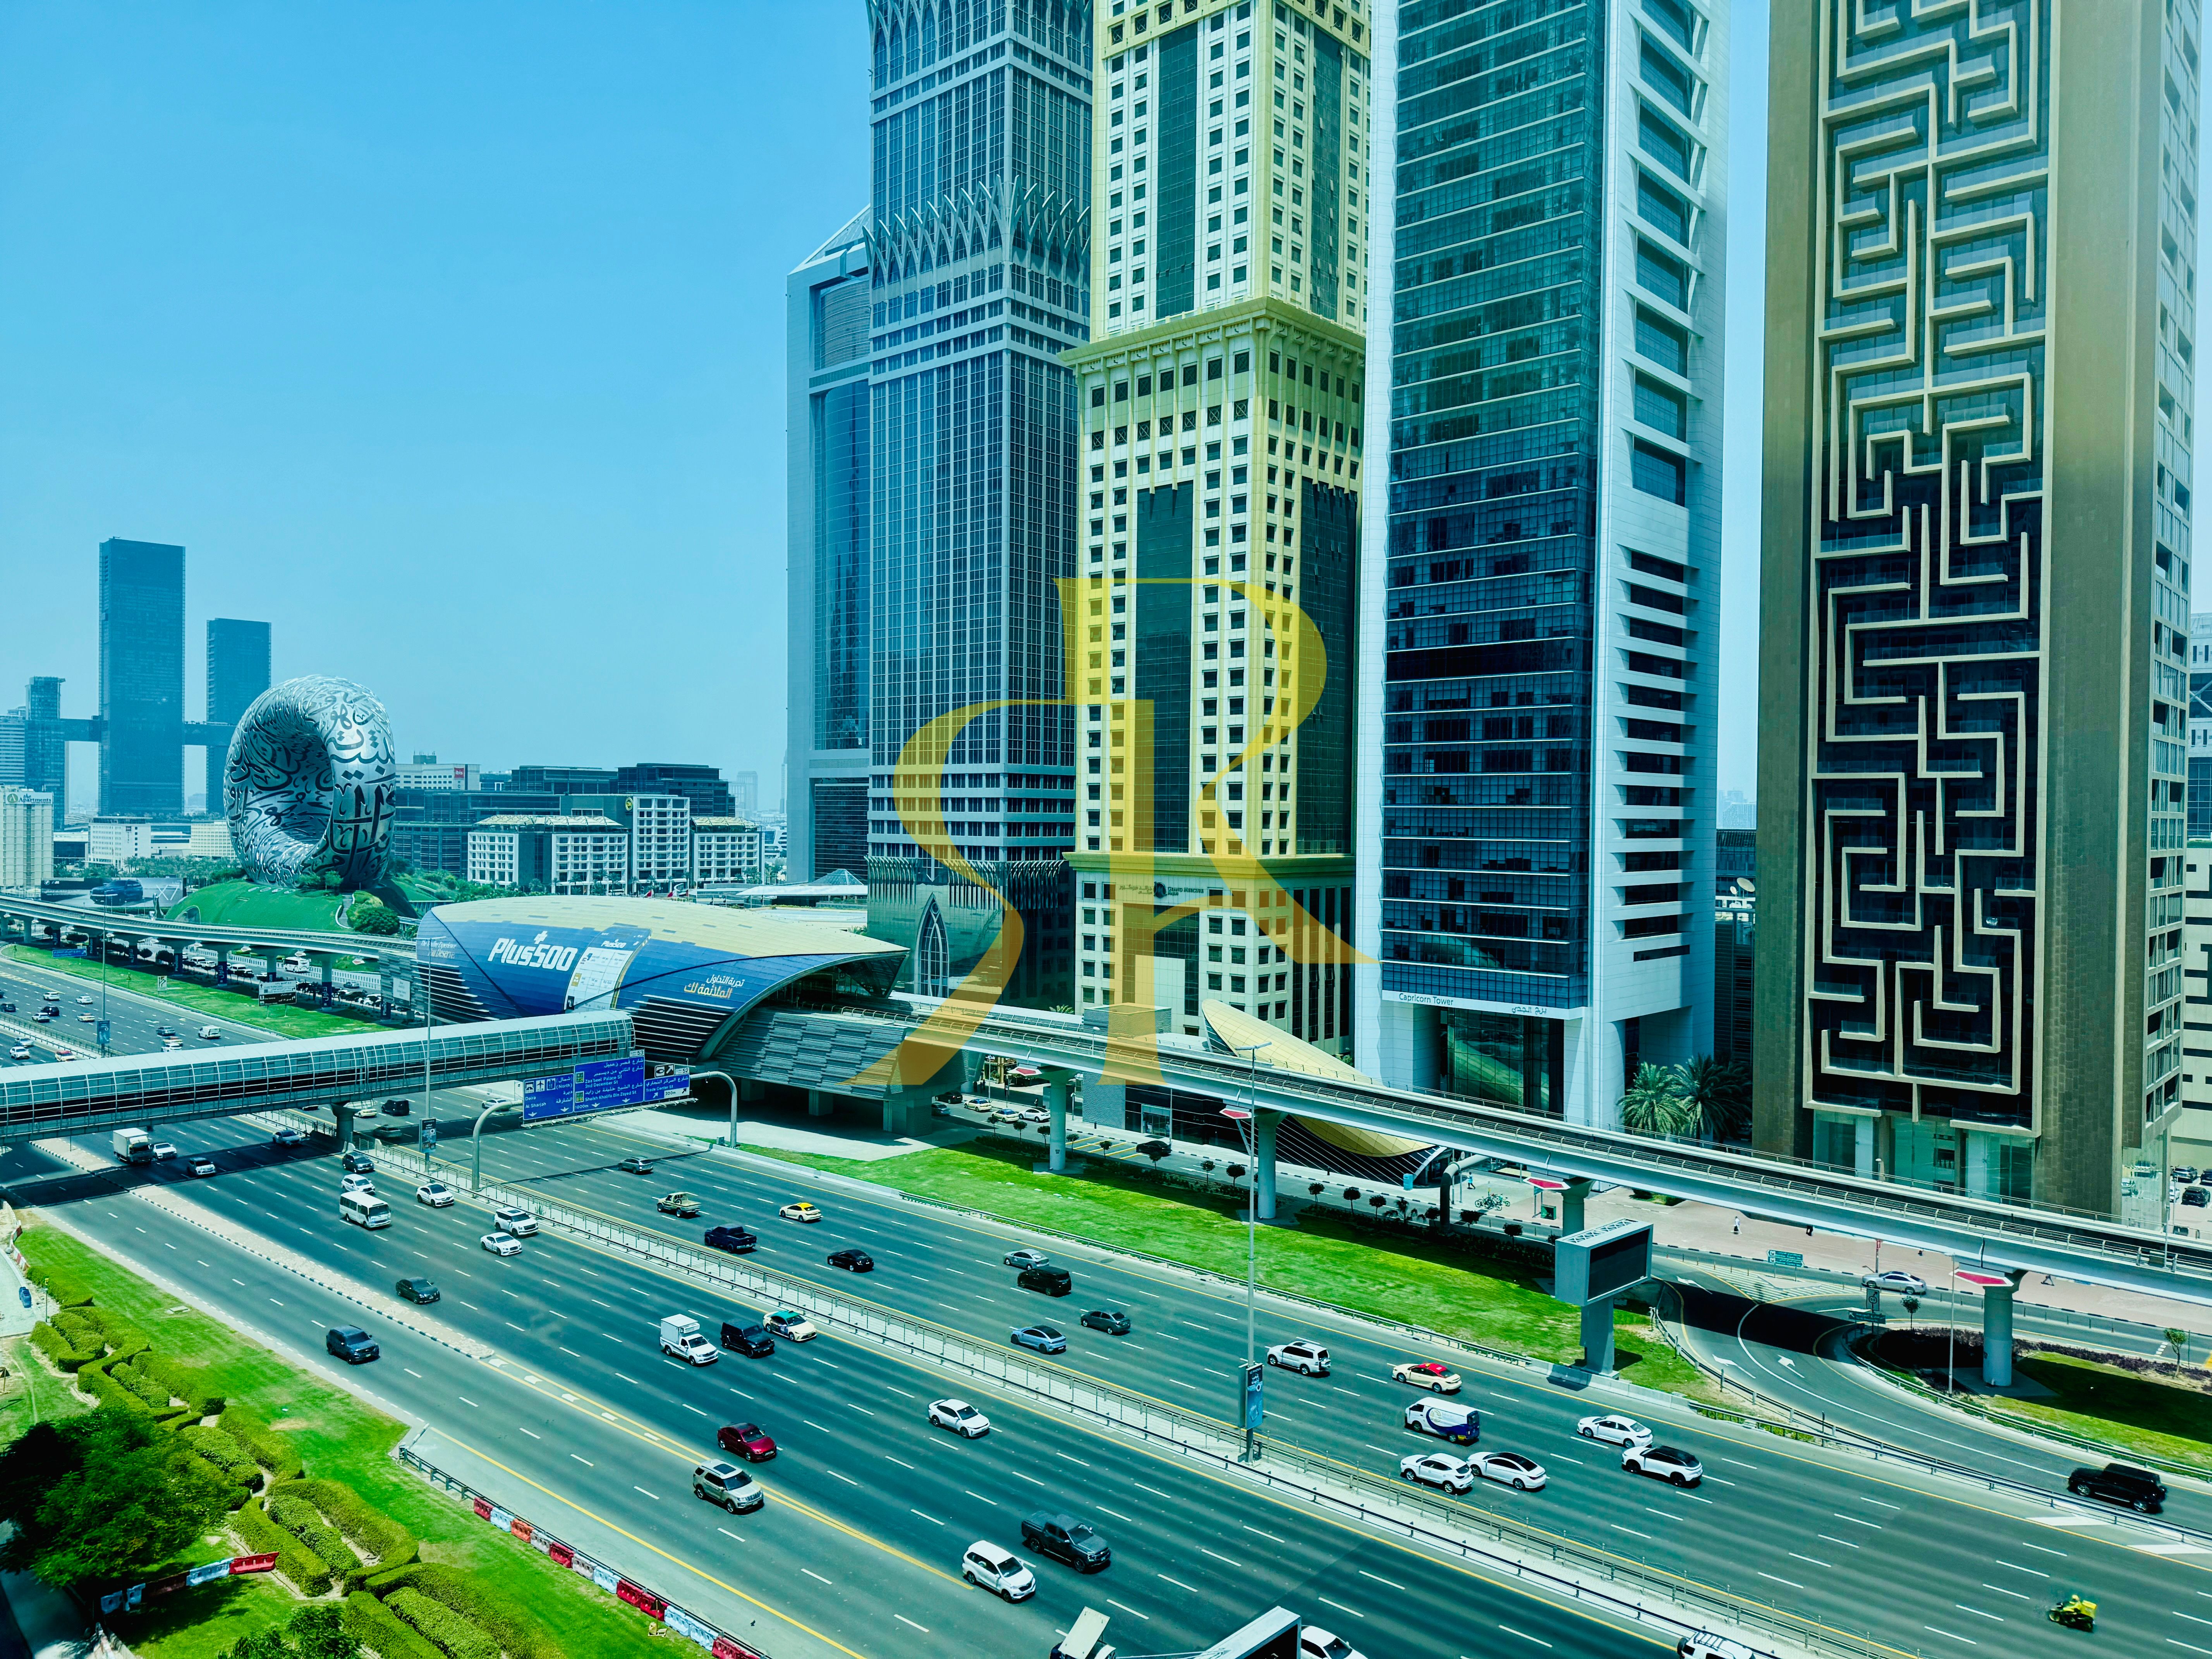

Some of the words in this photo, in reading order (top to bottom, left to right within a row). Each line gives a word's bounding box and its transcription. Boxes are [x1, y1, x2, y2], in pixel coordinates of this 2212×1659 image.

[156, 884, 179, 900] X7
[488, 938, 578, 971] Plus500
[1399, 993, 1431, 1003] Capricorn
[1433, 996, 1453, 1006] Tower
